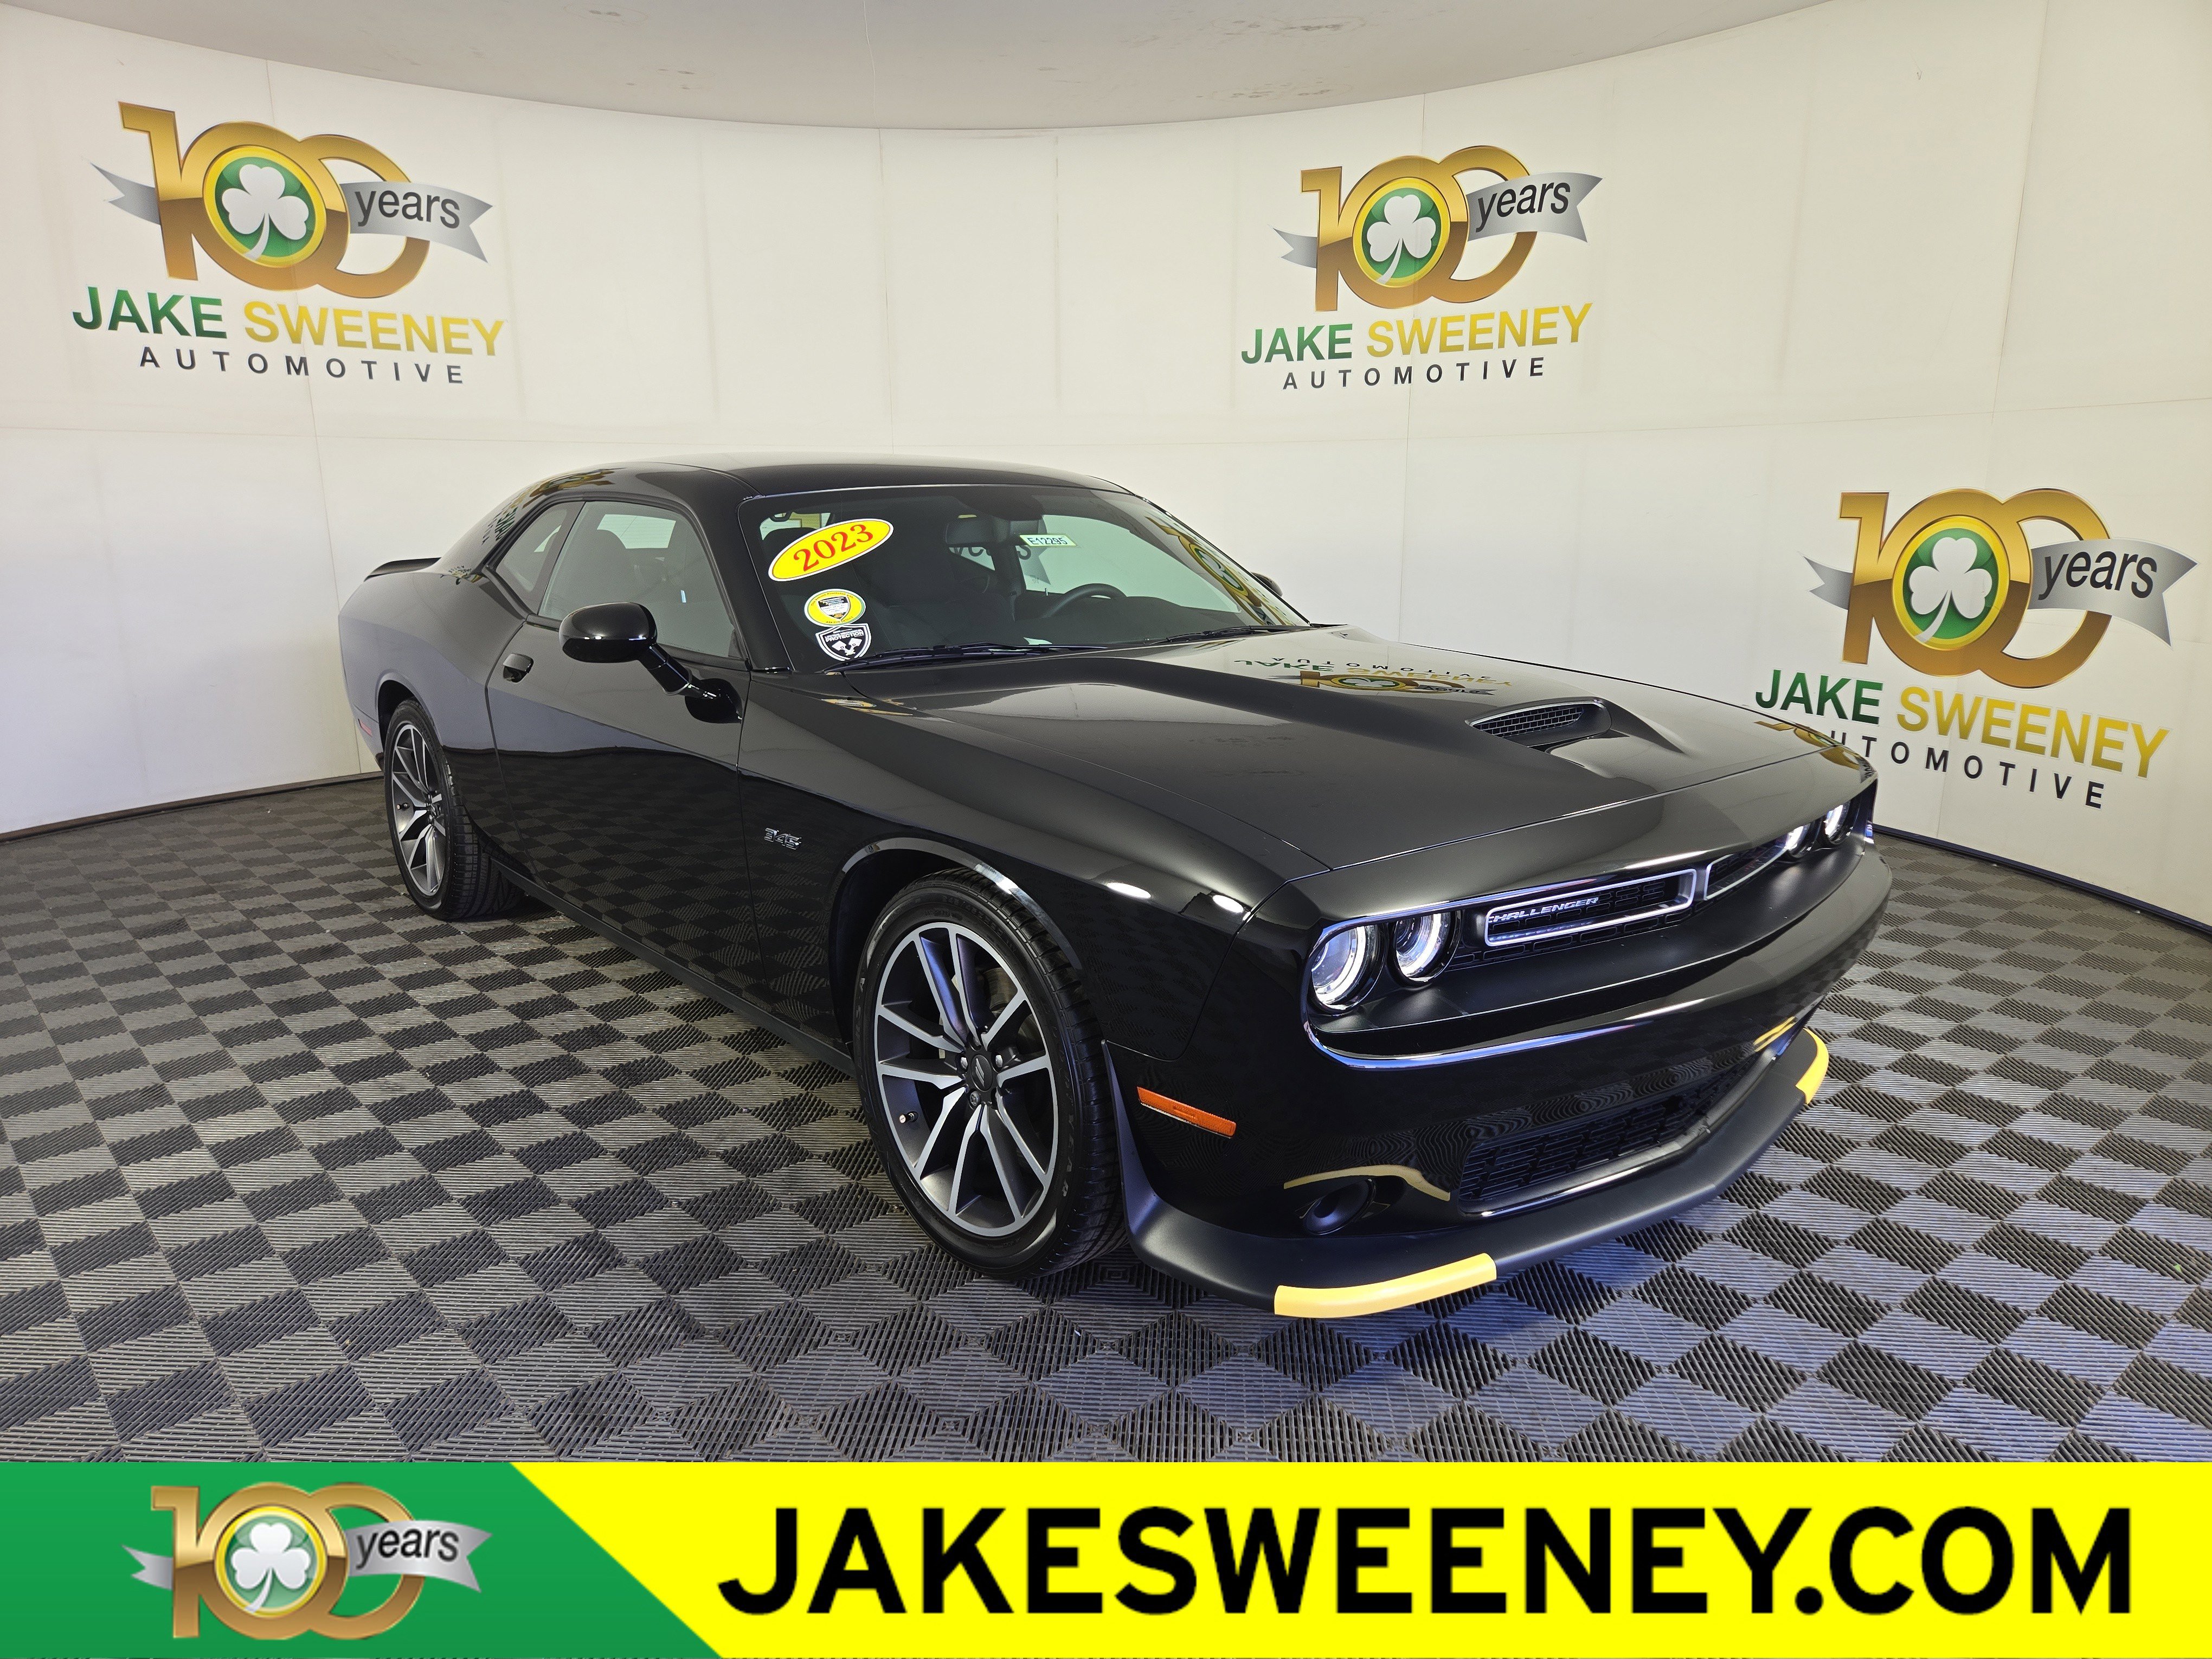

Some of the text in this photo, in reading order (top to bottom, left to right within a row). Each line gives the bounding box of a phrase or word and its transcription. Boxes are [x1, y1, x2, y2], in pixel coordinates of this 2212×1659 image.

[118, 101, 430, 299] 100
[355, 190, 461, 229] years
[1301, 145, 1538, 312] 100
[1475, 182, 1571, 233] years
[72, 286, 504, 356] JAKE SWEENEY
[1241, 303, 1593, 364] JAKE SWEENEY
[139, 346, 464, 384] AUTOMOTIVE
[1283, 357, 1545, 390] AUTOMOTIVE
[793, 524, 873, 572] 2023
[2037, 550, 2157, 600] years
[1839, 487, 2111, 689] 100
[1755, 669, 2170, 779] JAKE SWEENEY
[1830, 730, 2105, 808] TOMOTIVE
